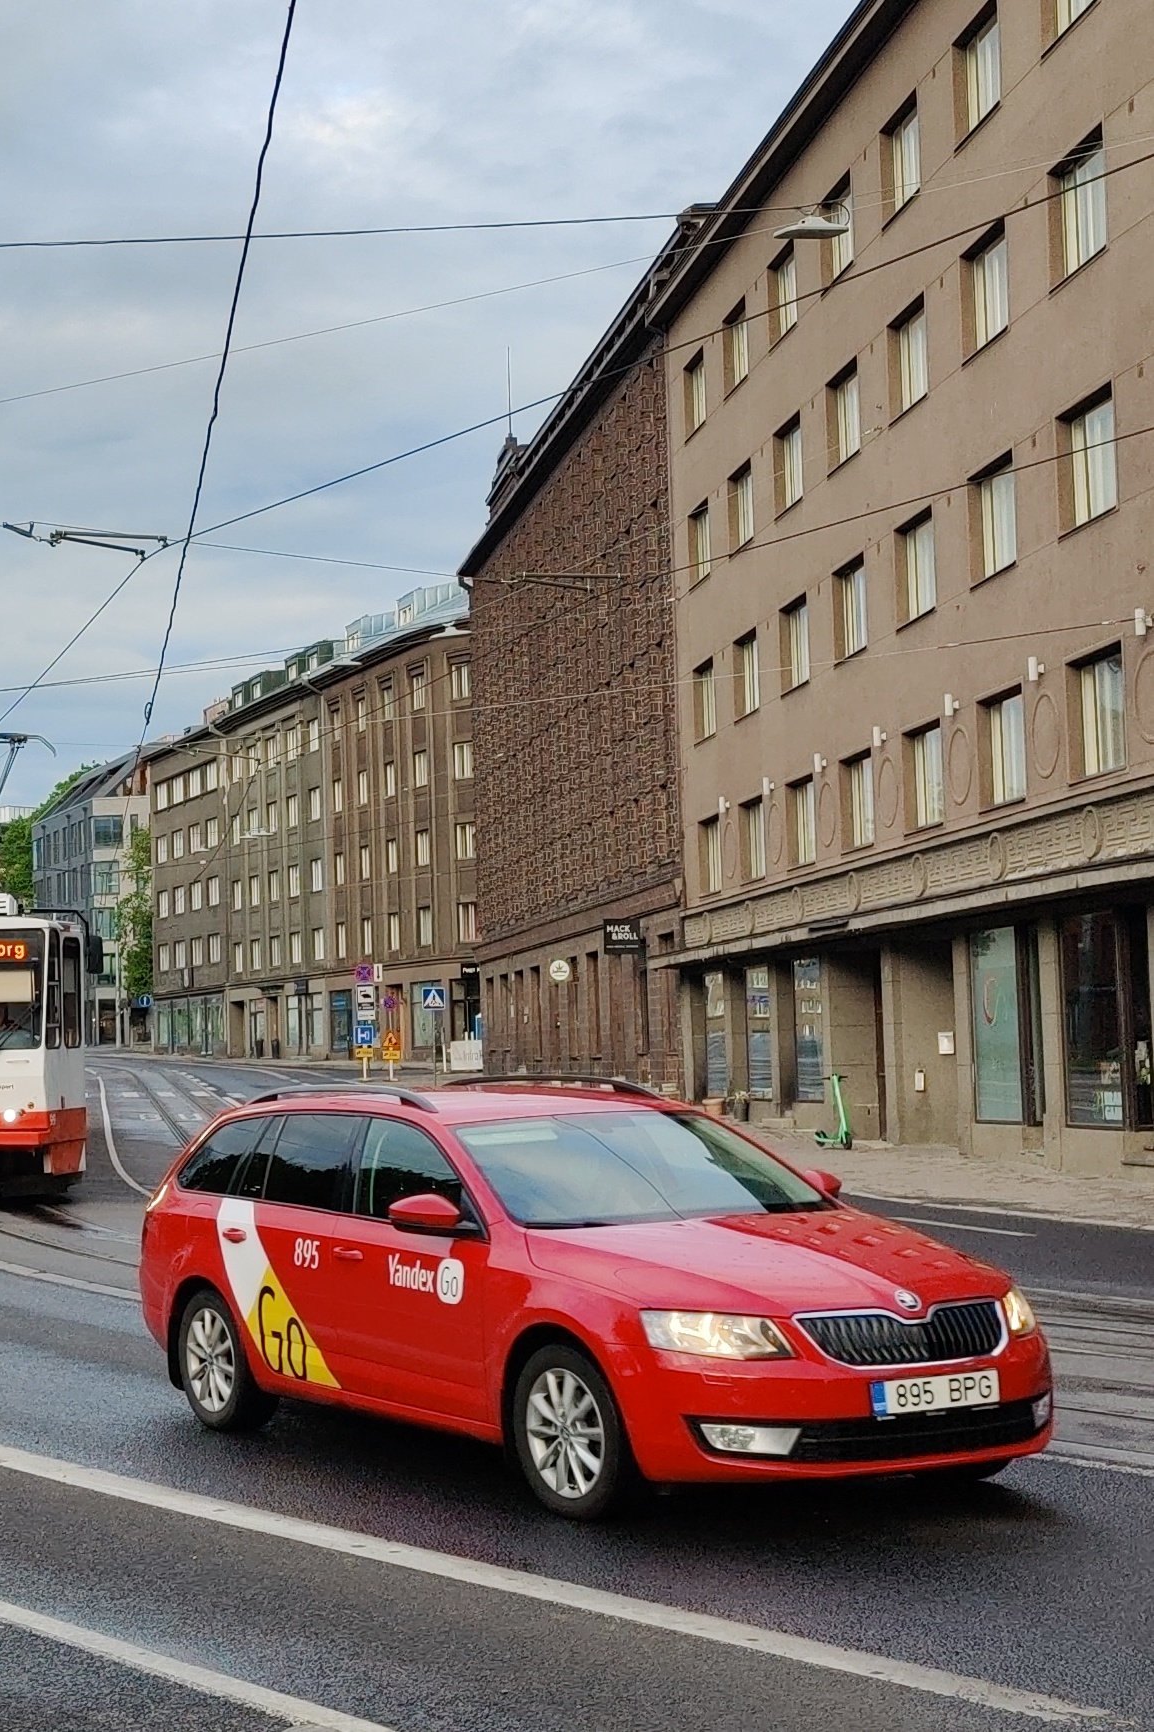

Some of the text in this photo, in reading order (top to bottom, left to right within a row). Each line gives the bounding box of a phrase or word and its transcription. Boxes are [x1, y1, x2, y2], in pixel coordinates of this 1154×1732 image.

[606, 925, 630, 933] MACK
[612, 932, 638, 940] &ROLL
[294, 1238, 320, 1269] 895
[388, 1253, 459, 1298] Yandex Go
[896, 1375, 993, 1408] 895 BPG
